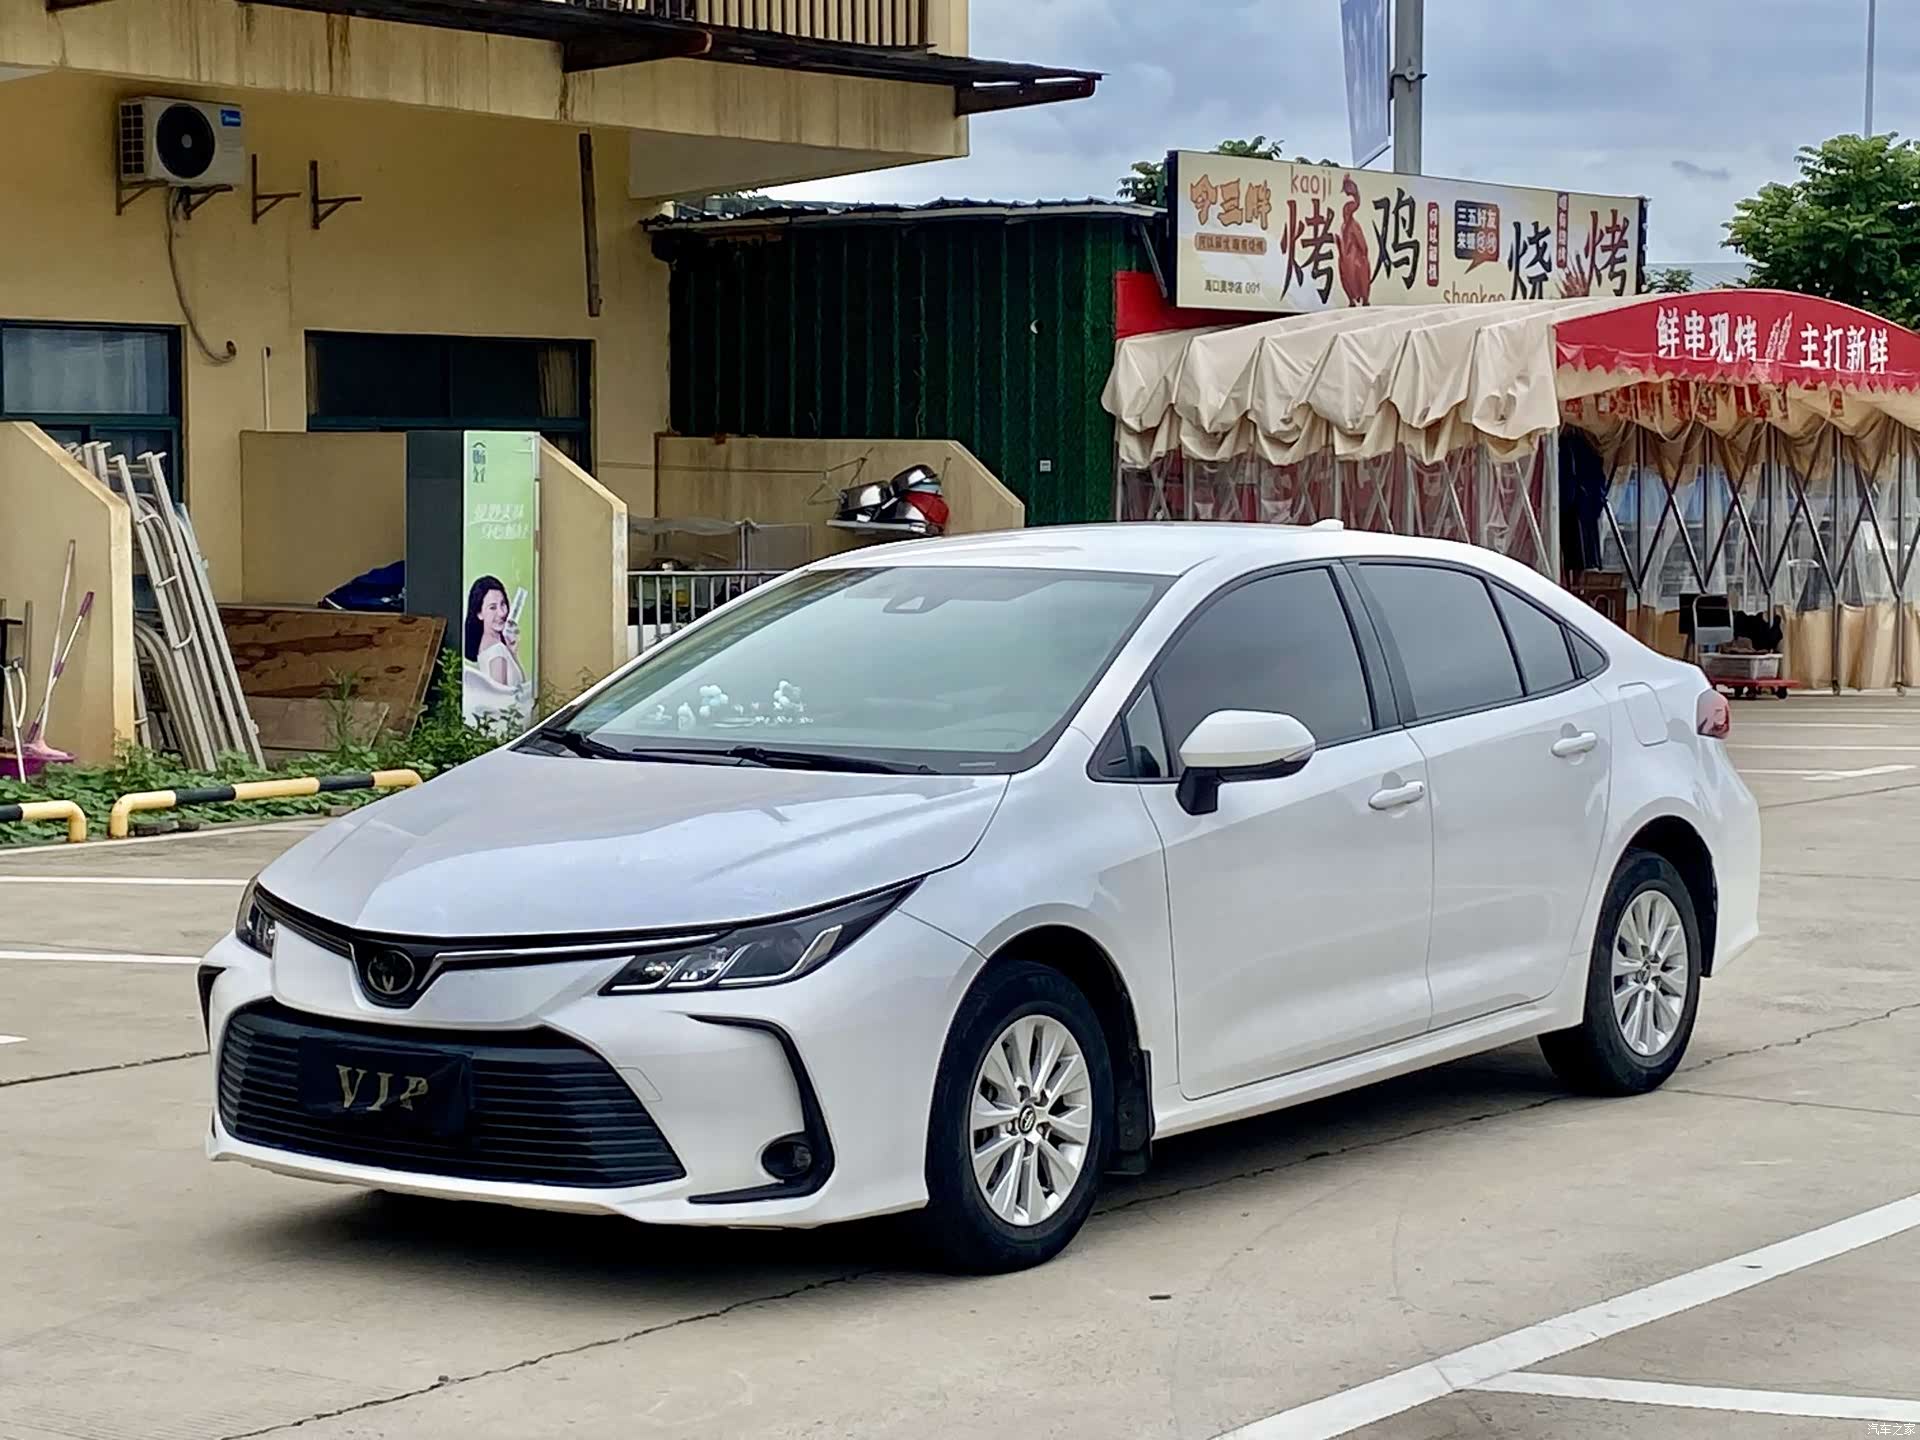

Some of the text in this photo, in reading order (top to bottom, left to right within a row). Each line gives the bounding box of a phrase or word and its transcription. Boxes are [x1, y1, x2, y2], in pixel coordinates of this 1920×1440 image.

[1290, 165, 1332, 201] kaoji
[1457, 207, 1497, 229] 三五好友
[1281, 188, 1629, 304] 烤鸡 烧烤
[1656, 306, 1889, 375] 鲜串现烤 主打新鲜
[336, 1064, 429, 1111] VIP
